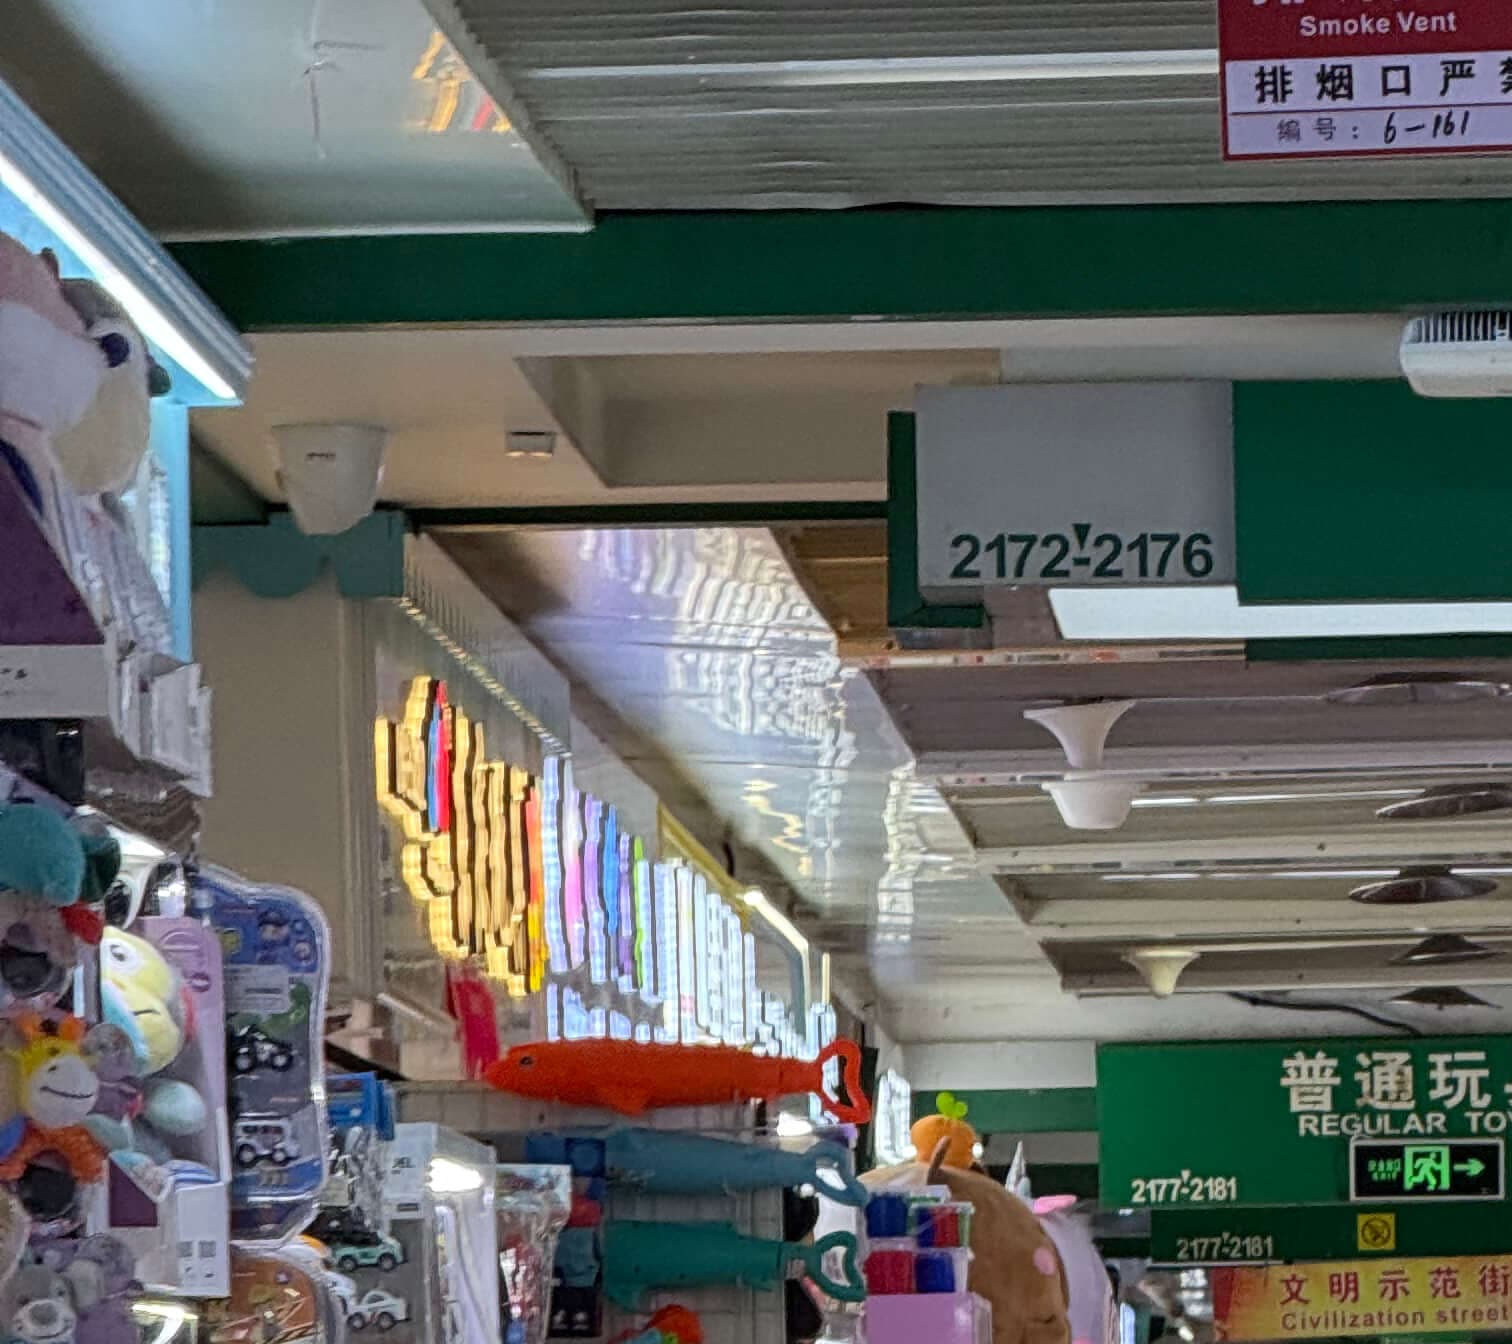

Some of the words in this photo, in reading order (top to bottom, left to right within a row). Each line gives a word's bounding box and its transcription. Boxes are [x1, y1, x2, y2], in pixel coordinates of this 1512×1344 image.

[1300, 15, 1390, 38] Smoke
[1395, 10, 1458, 34] Vent
[1382, 110, 1471, 145] 6-161
[950, 532, 1214, 579] 2172-2176
[1298, 1111, 1448, 1137] REGULAR
[1131, 1176, 1239, 1203] 2177-2181
[1177, 1235, 1273, 1259] 2177-2181
[1278, 1263, 1512, 1307] 文明示范街
[1281, 1306, 1426, 1331] Civilization
[1435, 1304, 1510, 1323] street
